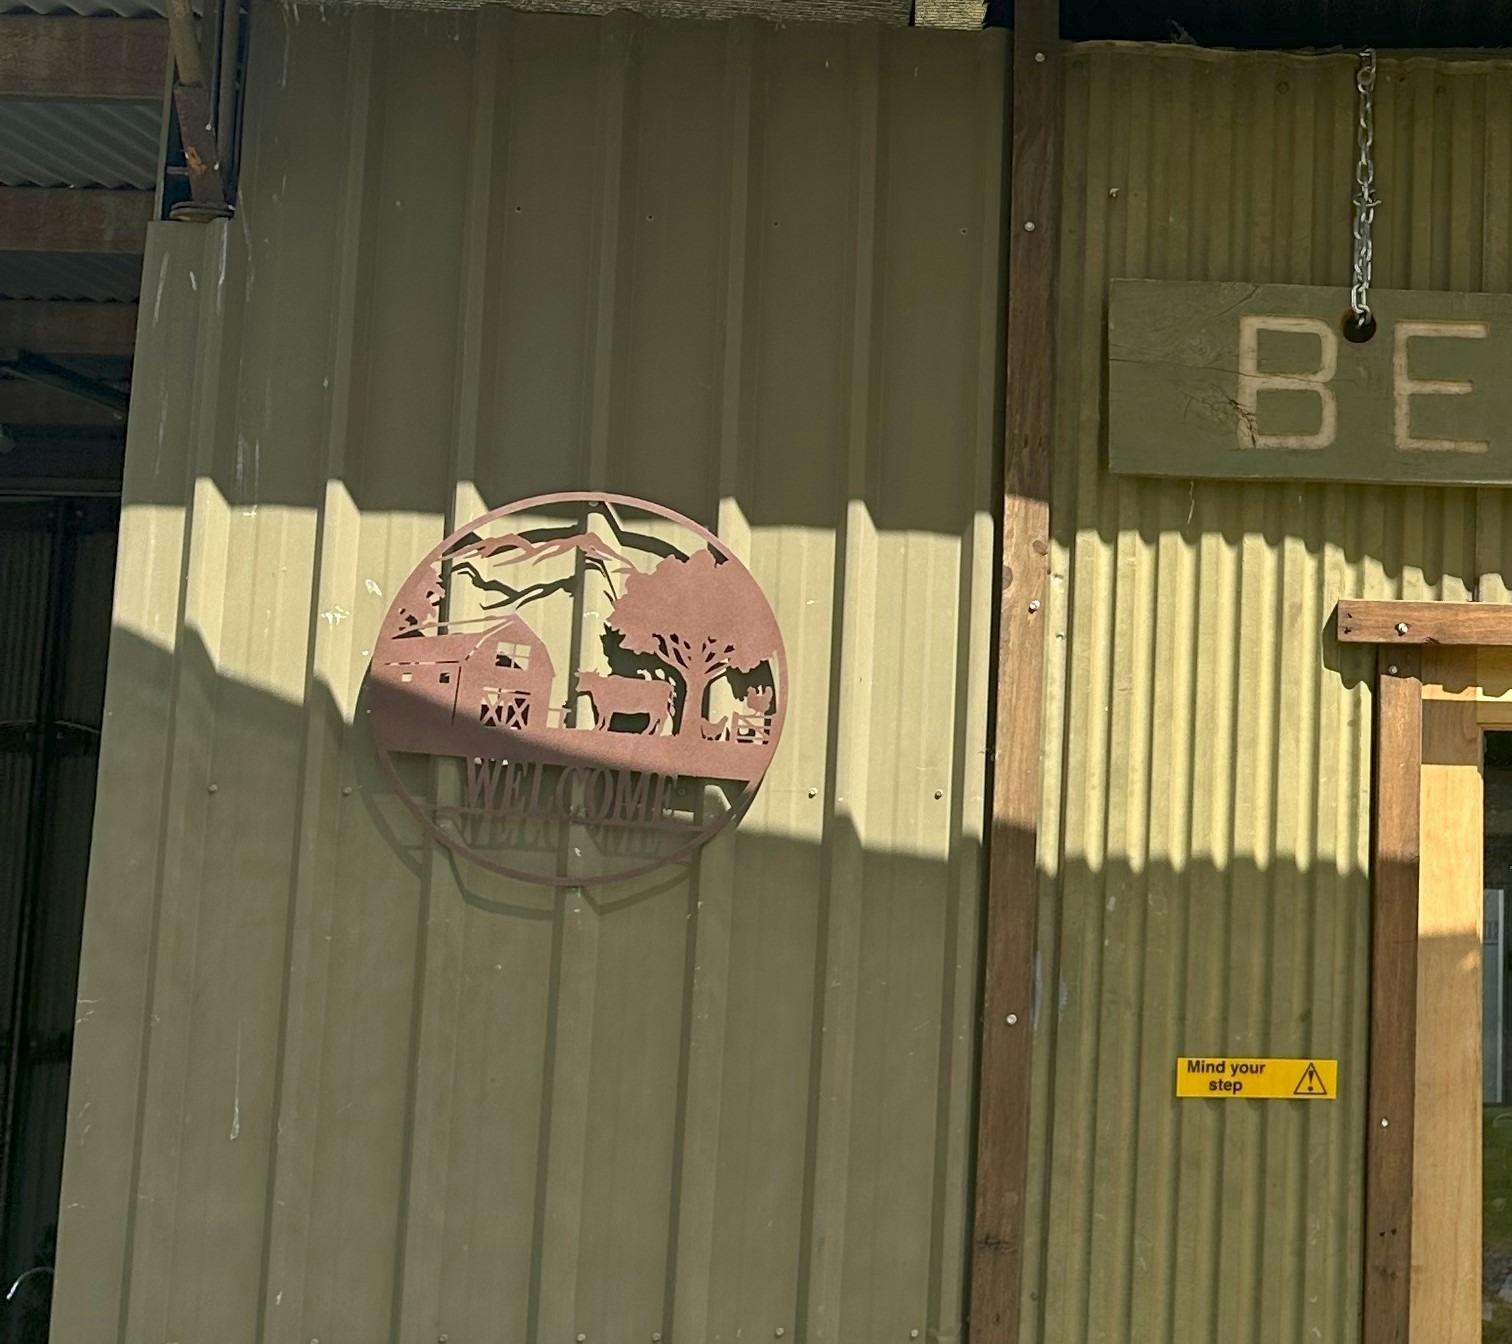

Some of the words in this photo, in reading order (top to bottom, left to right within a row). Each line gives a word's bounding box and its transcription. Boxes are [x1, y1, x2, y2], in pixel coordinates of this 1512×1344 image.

[466, 755, 679, 824] WELCOME
[1187, 1059, 1226, 1074] Mind
[1230, 1061, 1266, 1077] your
[1208, 1079, 1243, 1094] step
